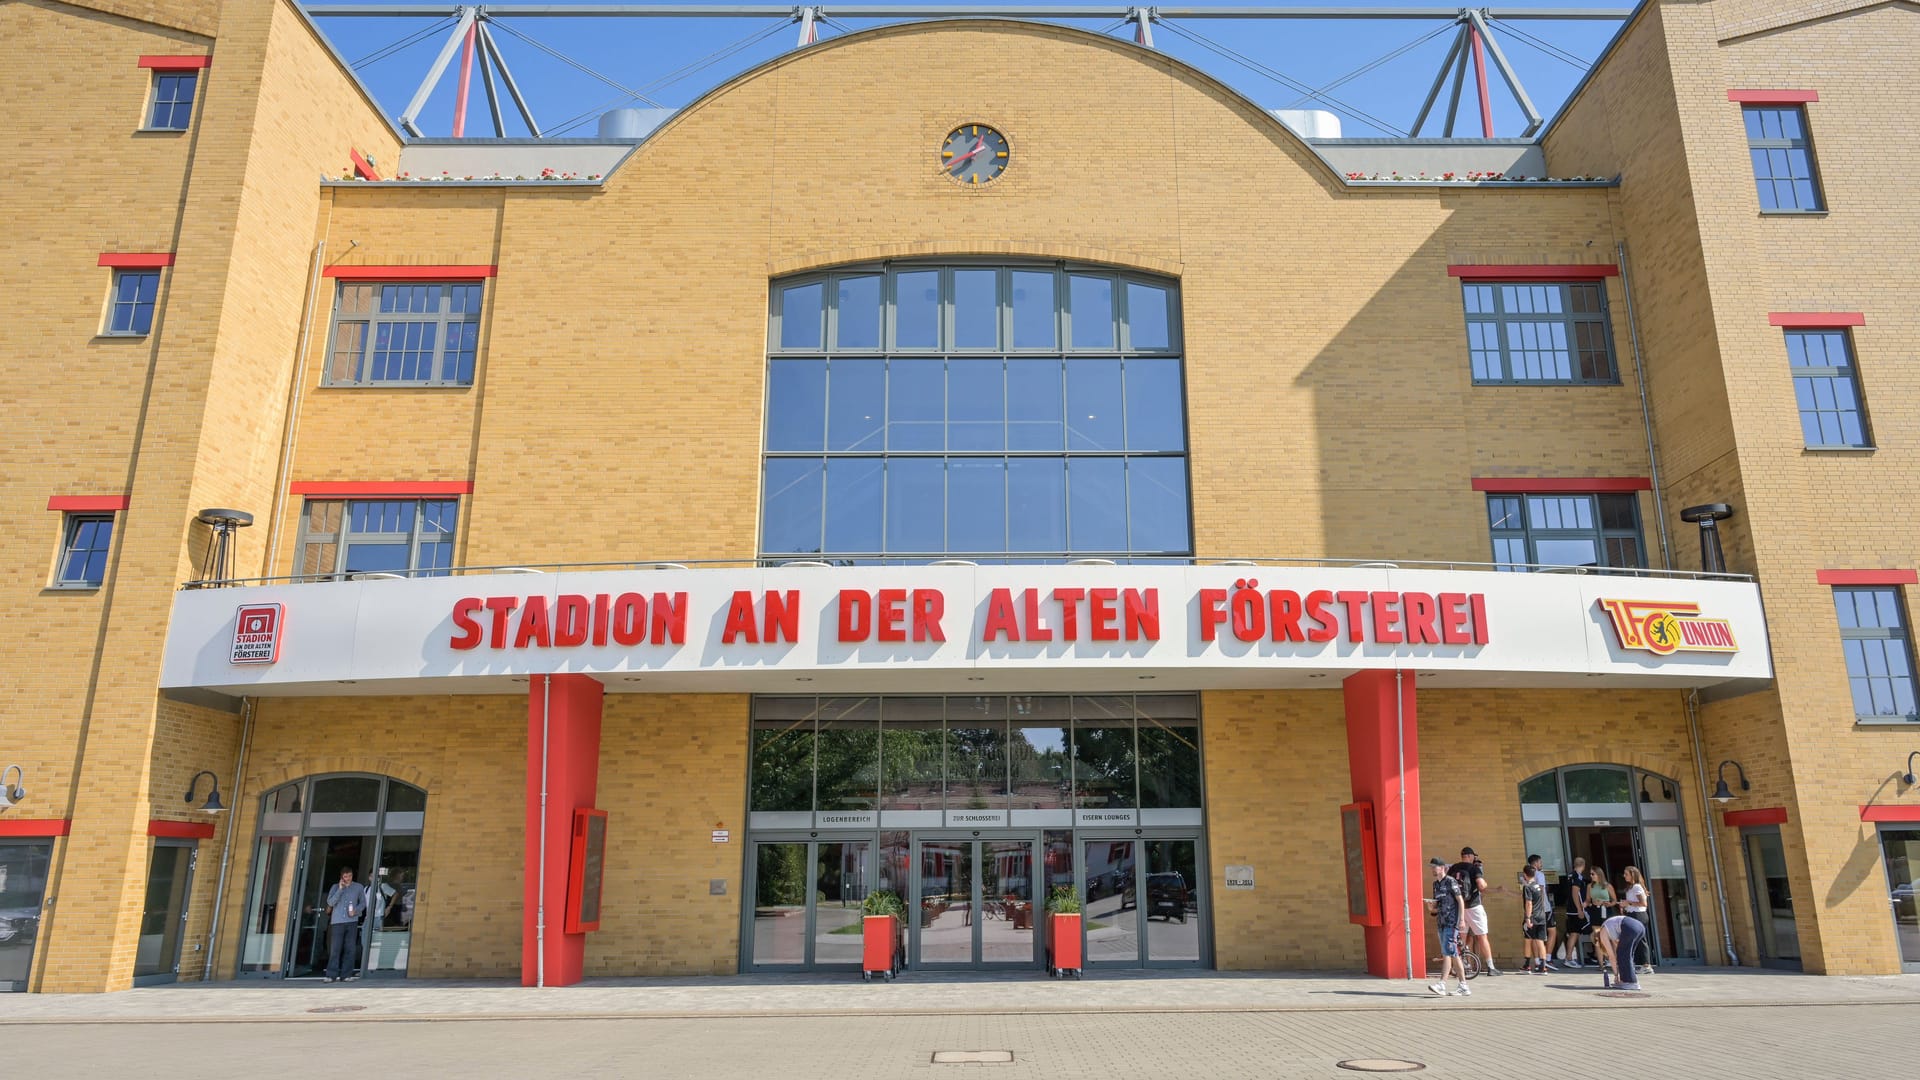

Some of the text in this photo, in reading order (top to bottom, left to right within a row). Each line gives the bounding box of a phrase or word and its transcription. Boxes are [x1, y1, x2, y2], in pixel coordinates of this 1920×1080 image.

[450, 578, 1489, 649] STADION AN DER ALTEN FÖRSTEREI
[236, 634, 272, 643] STADION
[1679, 621, 1734, 646] UNION
[234, 650, 270, 658] FÖRSTEREI
